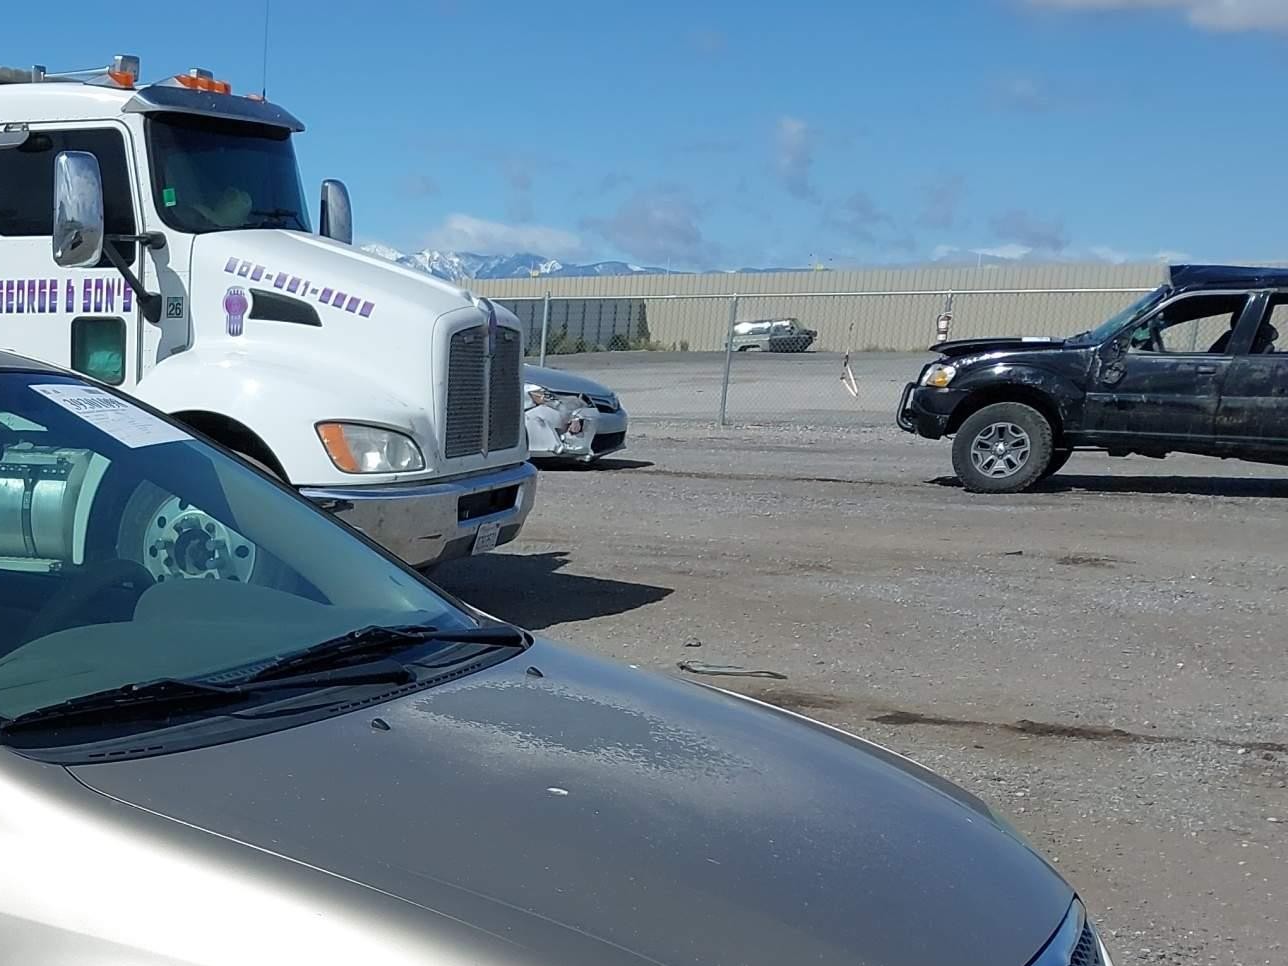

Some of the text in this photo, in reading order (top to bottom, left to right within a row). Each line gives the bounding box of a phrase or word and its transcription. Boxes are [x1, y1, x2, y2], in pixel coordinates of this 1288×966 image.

[65, 279, 75, 313] &
[82, 278, 133, 313] SON'S
[168, 302, 182, 316] 26
